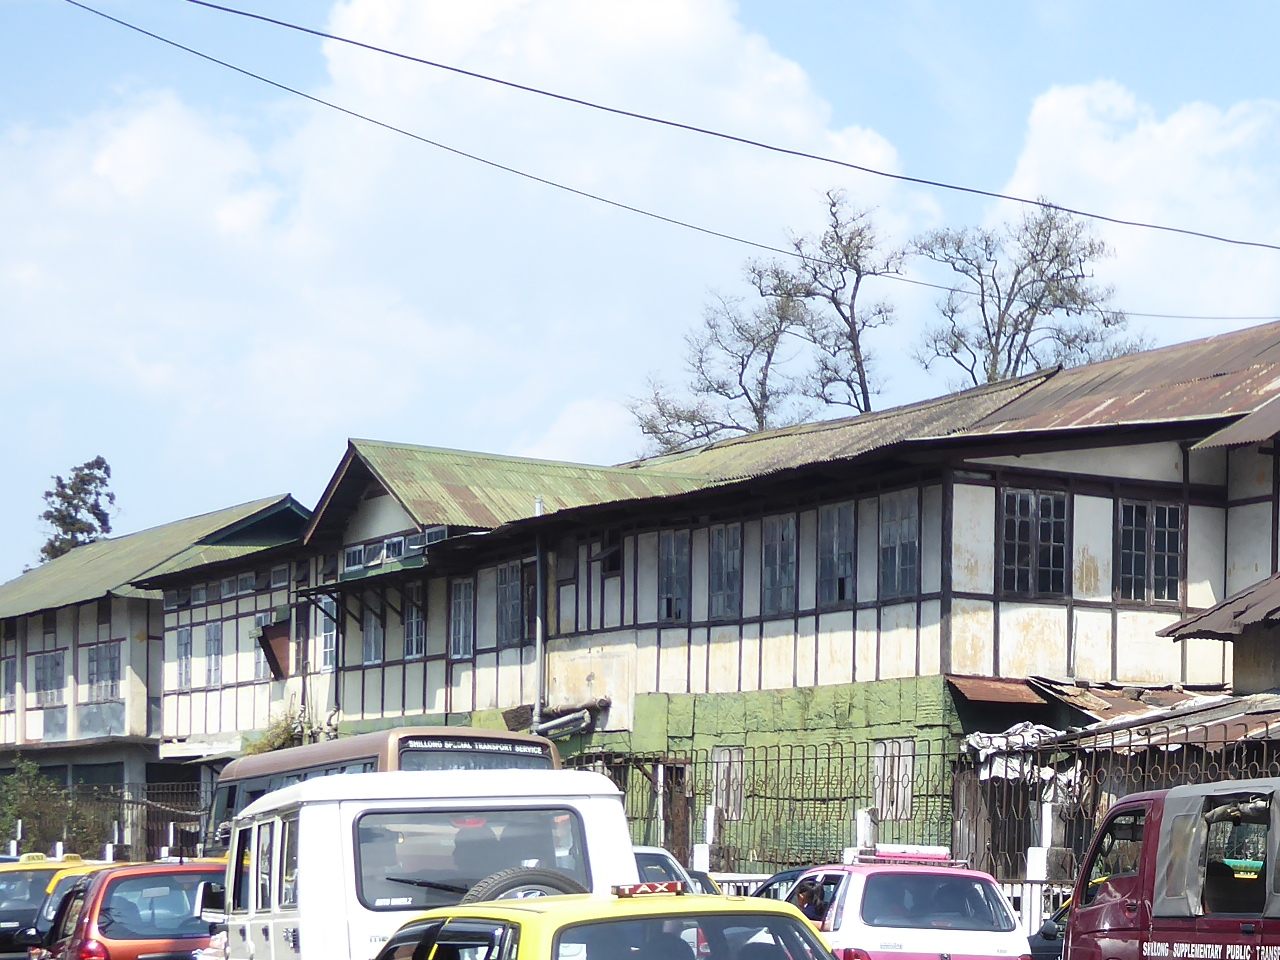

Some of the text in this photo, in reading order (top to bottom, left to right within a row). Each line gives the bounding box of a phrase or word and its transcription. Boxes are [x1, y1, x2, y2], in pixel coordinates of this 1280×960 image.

[514, 744, 543, 755] SERVICE
[619, 881, 682, 895] TAXI
[1172, 943, 1223, 960] SUPPLEMENTARY
[1225, 944, 1252, 960] PUBLIC
